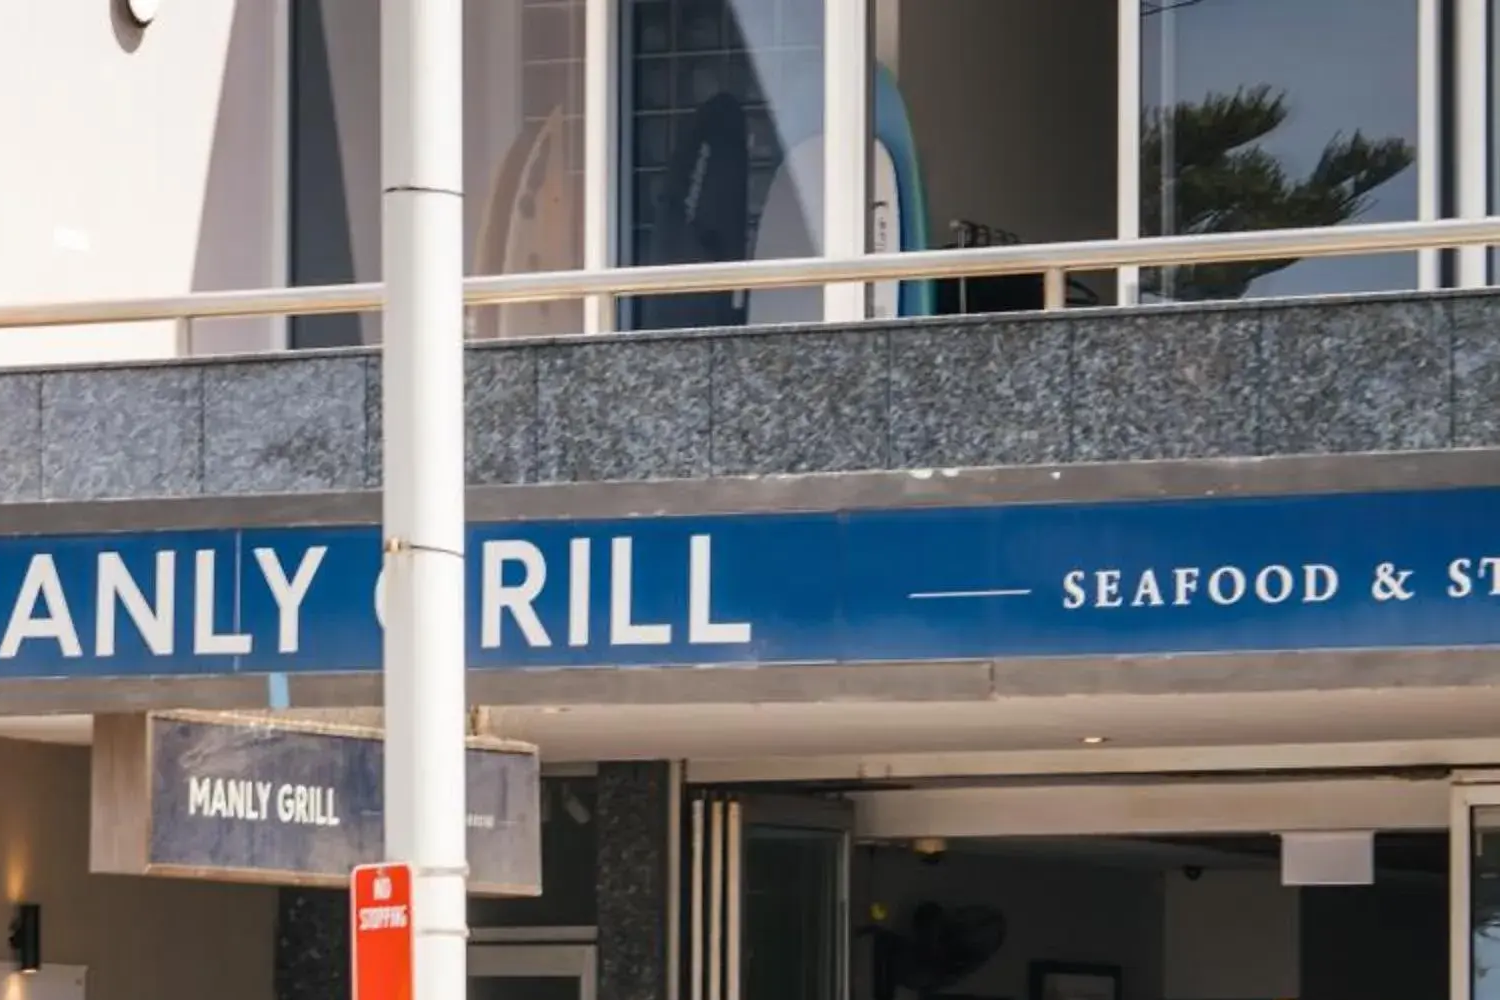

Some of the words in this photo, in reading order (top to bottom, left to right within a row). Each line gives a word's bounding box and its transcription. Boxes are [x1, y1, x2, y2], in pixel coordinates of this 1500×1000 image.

[375, 533, 753, 650] RILL
[1062, 564, 1340, 609] SEAFOOD
[1371, 562, 1414, 600] &
[188, 776, 272, 821] MANLY
[277, 782, 341, 827] GRILL
